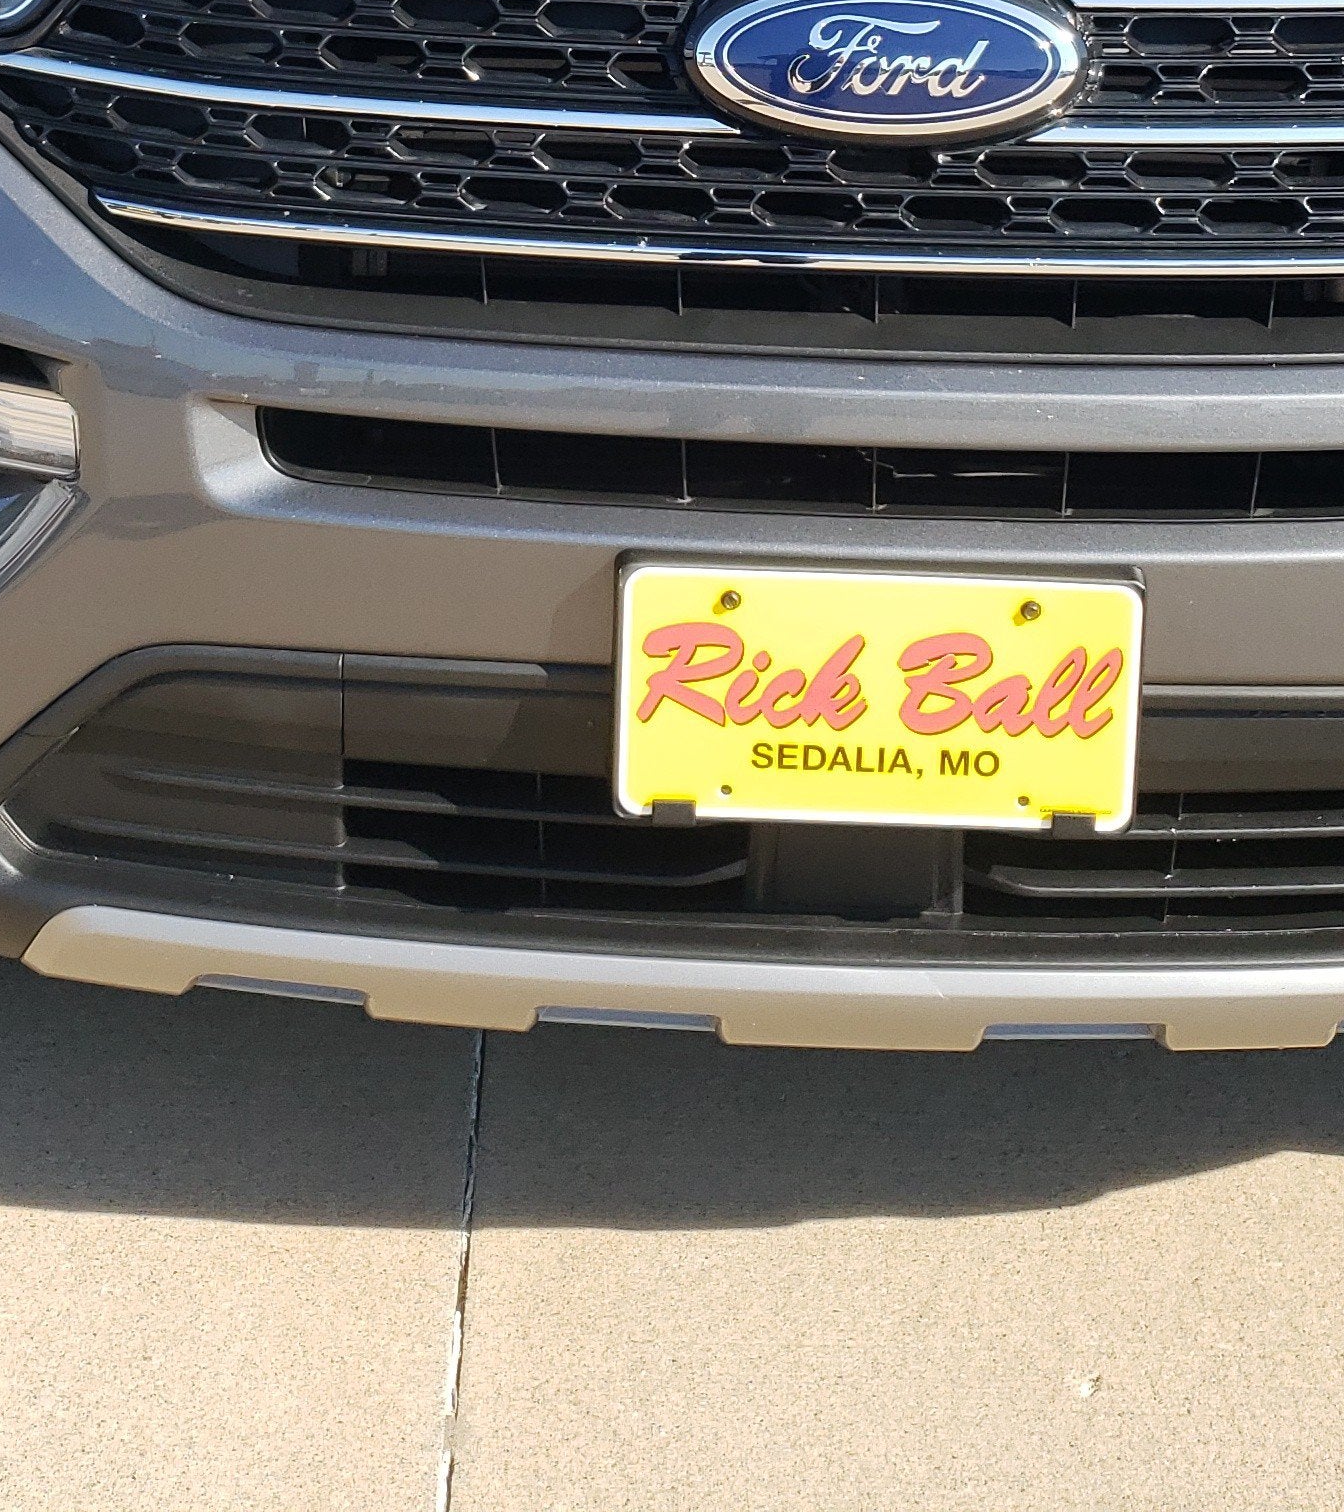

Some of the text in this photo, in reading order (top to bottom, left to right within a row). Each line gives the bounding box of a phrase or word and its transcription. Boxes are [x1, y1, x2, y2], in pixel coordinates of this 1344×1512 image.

[787, 13, 990, 98] Ford
[636, 621, 1123, 739] Rick Ball
[750, 742, 1001, 780] SEDALIA, MO
